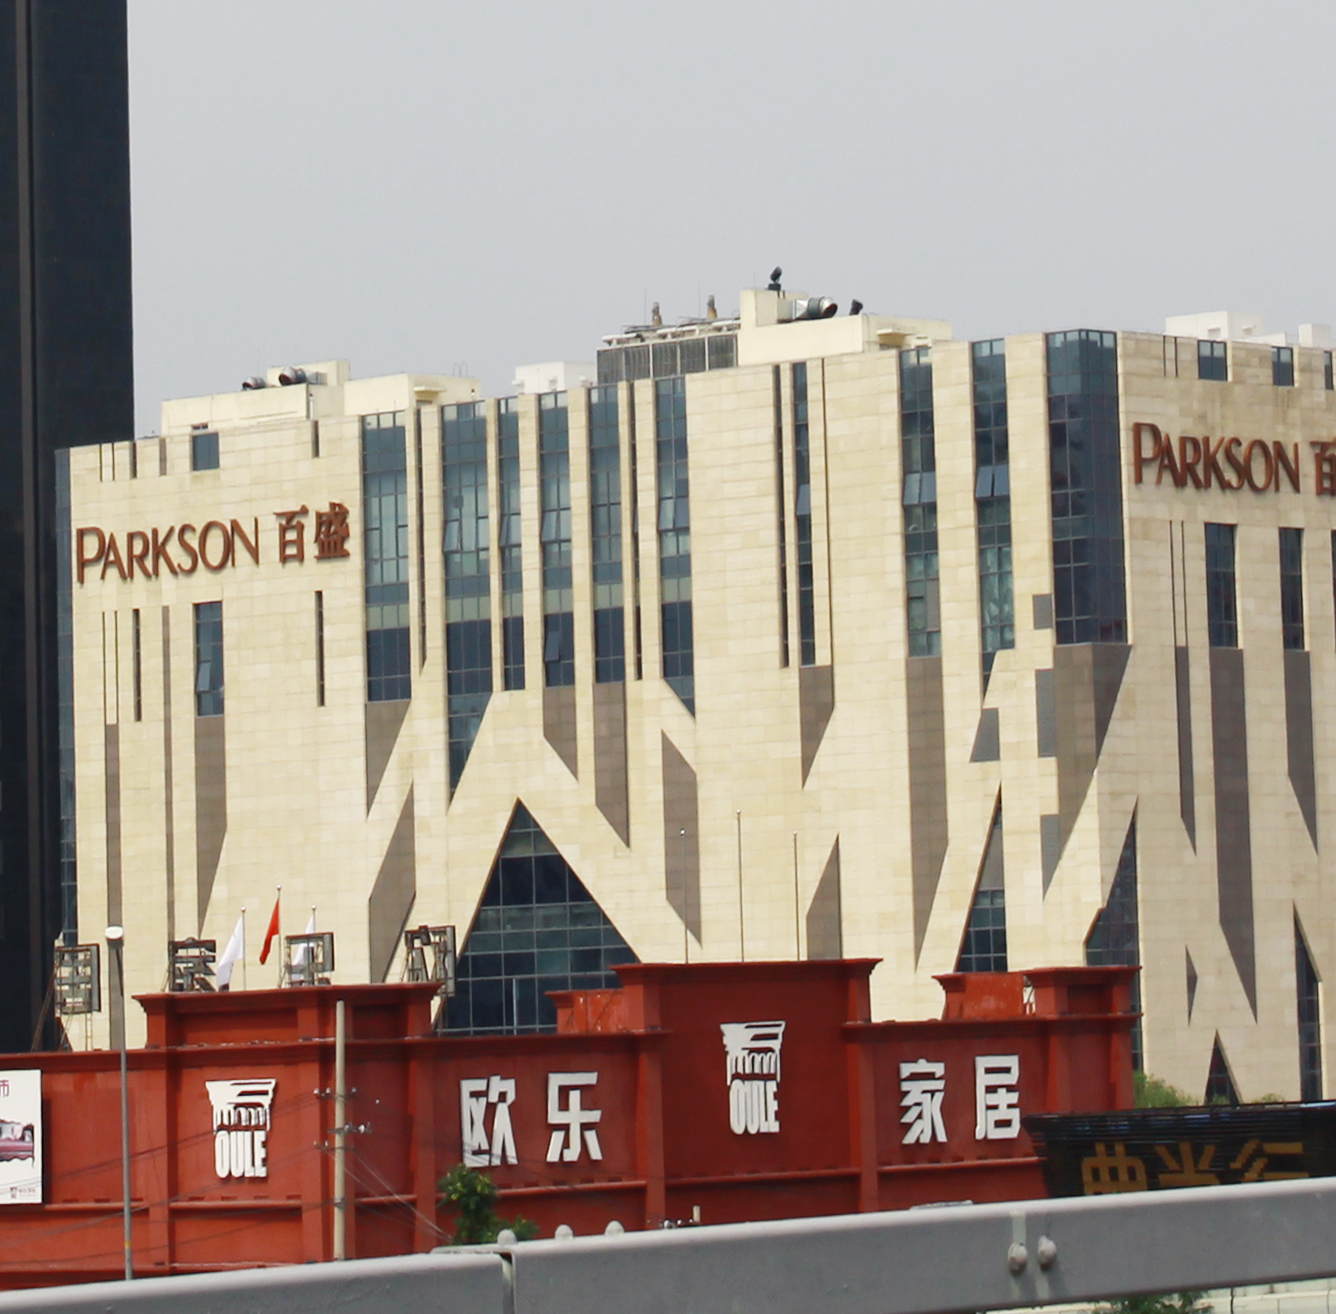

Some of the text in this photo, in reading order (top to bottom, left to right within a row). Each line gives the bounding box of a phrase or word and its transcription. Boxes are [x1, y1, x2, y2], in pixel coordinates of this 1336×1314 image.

[1132, 421, 1301, 494] PARKSON
[76, 501, 351, 584] PARKSON 百盛
[729, 1079, 781, 1135] OULE
[215, 1130, 267, 1178] OULE
